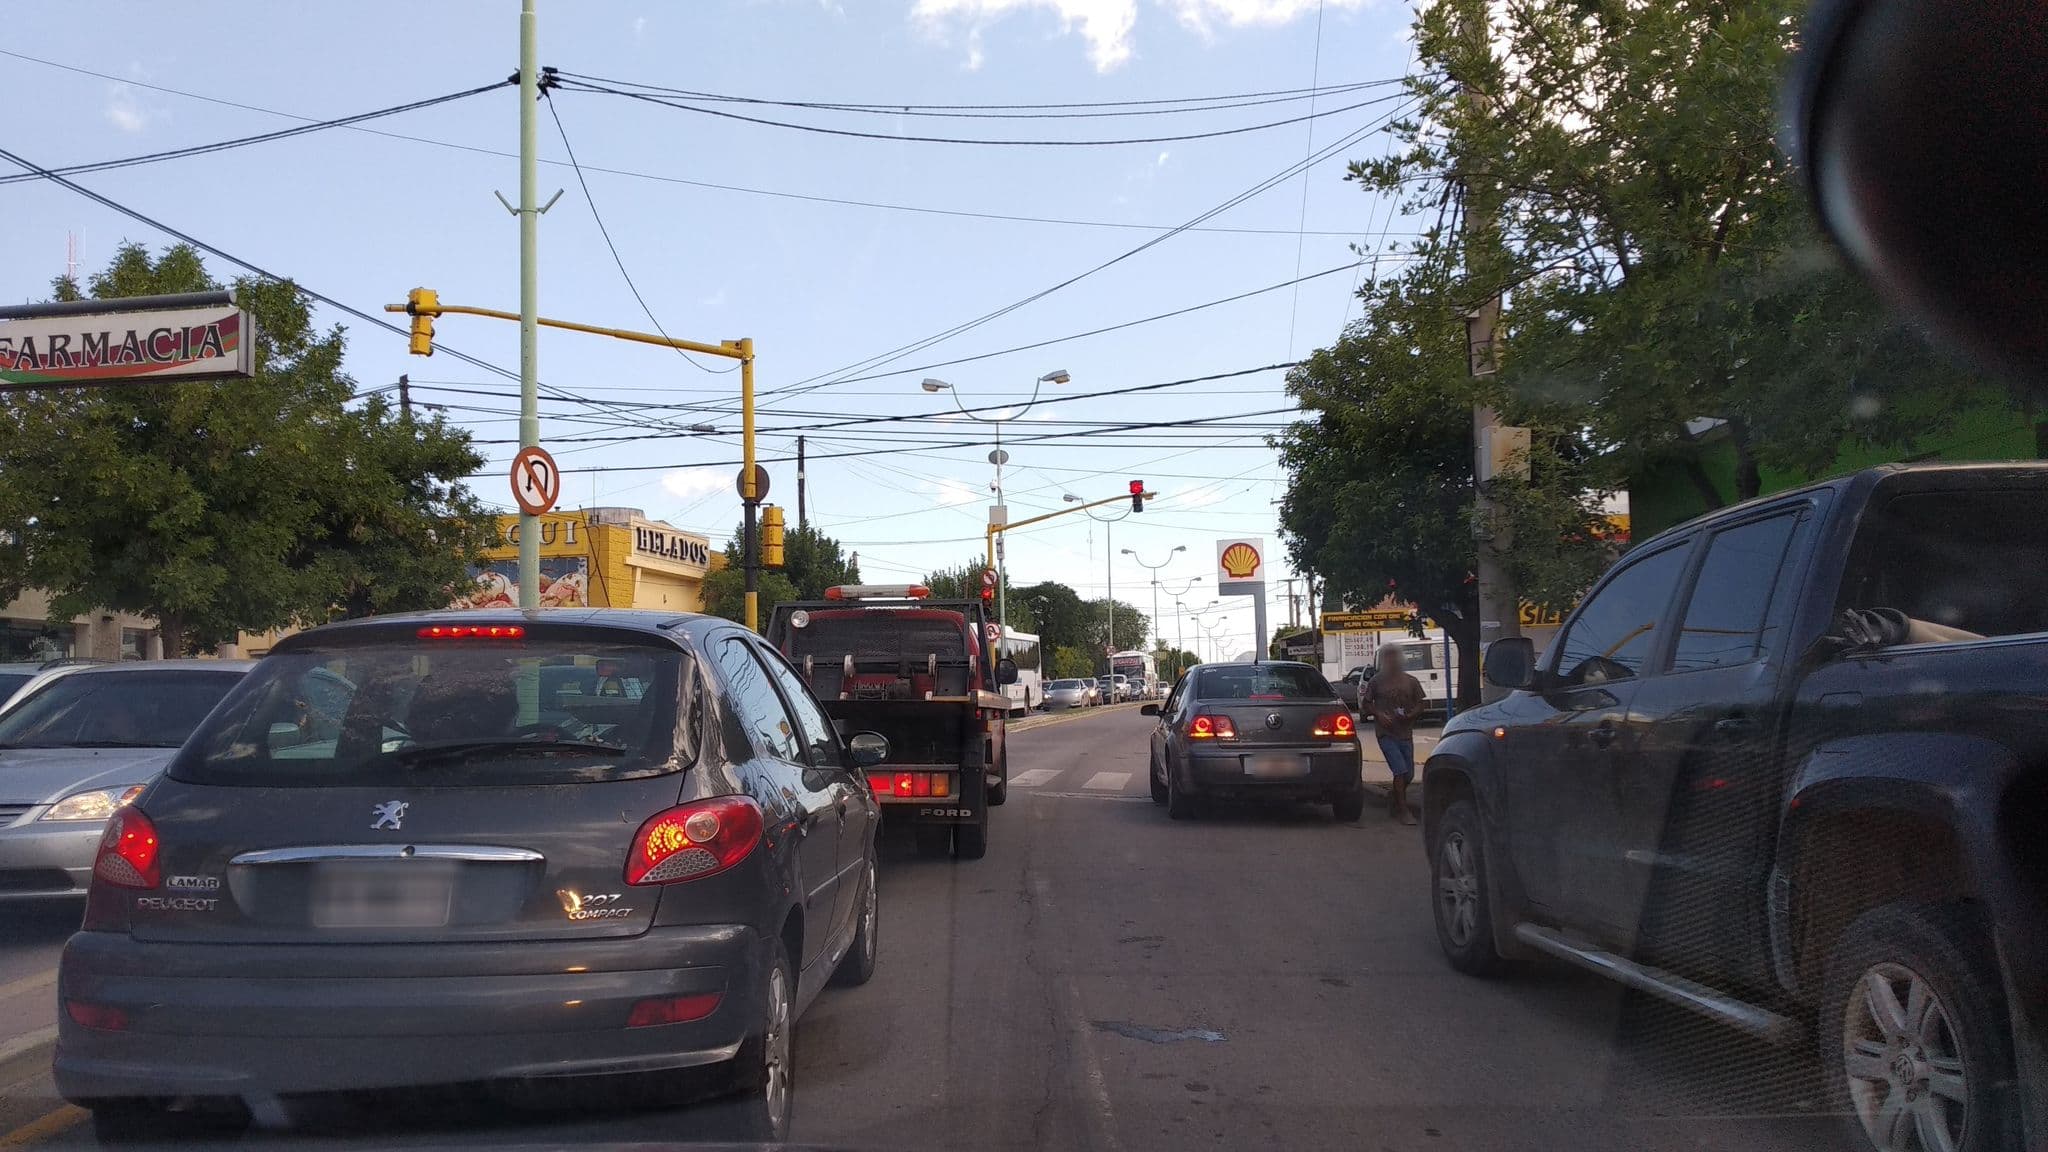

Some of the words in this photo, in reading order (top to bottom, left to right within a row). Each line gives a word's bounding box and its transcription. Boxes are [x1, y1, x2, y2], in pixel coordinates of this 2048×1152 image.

[0, 323, 226, 371] FARMACIA
[636, 526, 709, 565] HELADOS
[920, 808, 972, 817] FORD
[167, 877, 219, 889] LAMAR
[137, 897, 219, 911] PEUGEOT
[582, 893, 622, 907] 207
[568, 908, 634, 920] COMPACT
